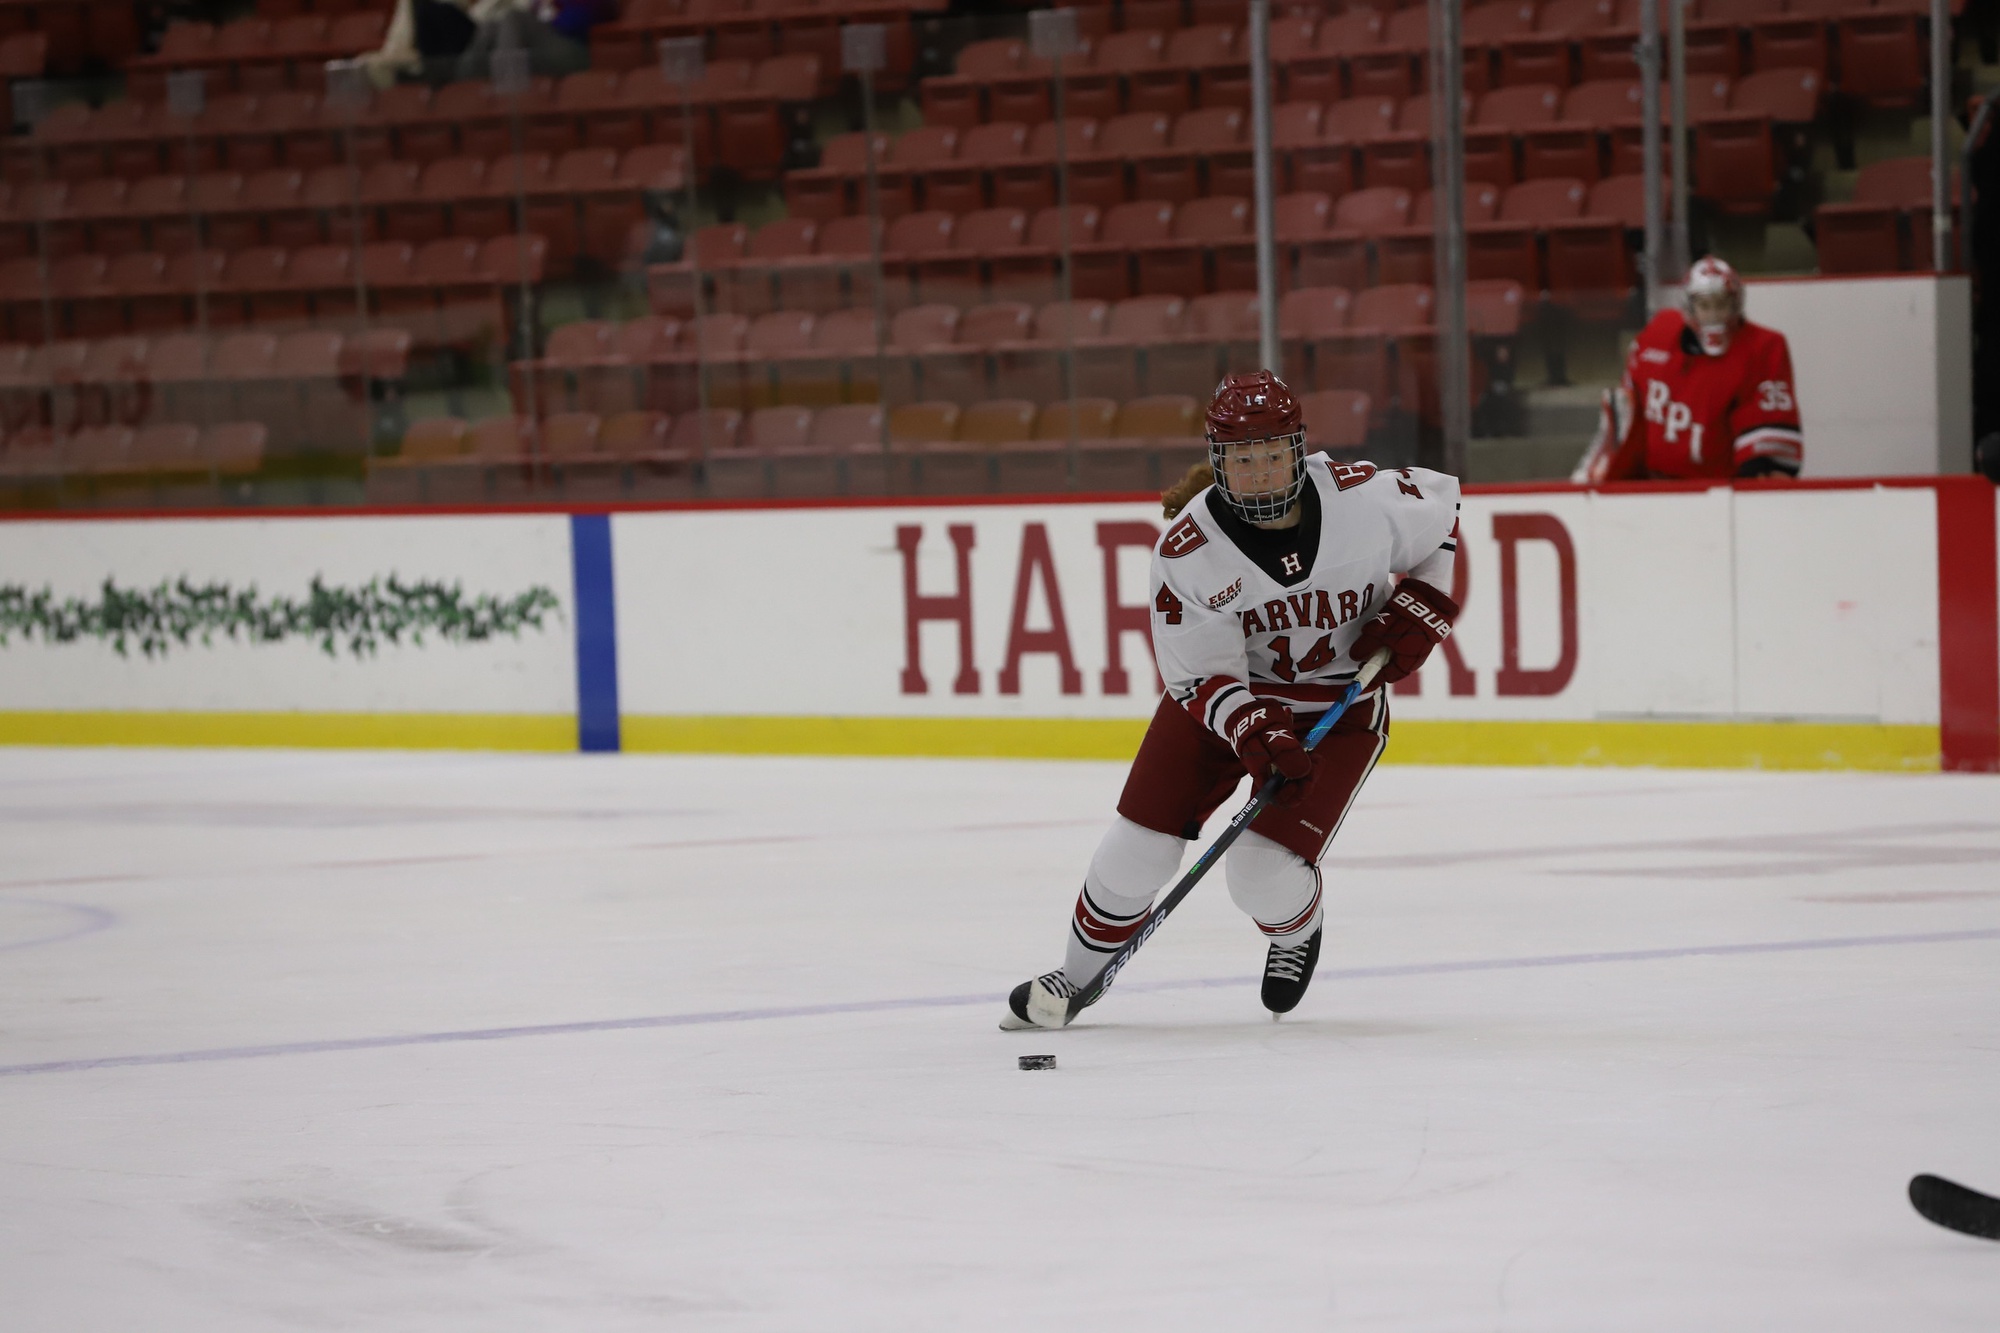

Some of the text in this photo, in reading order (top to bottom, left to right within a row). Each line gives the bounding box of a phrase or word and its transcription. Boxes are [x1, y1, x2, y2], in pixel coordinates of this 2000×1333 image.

[1245, 394, 1267, 406] 14
[1758, 380, 1793, 411] 35
[1645, 378, 1704, 463] RPI
[1334, 464, 1366, 481] H
[1167, 522, 1198, 552] H
[1281, 552, 1302, 576] H
[894, 511, 1579, 697] HARD
[1208, 577, 1242, 605] ECAC
[1236, 582, 1375, 640] ARVARD
[1267, 632, 1337, 683] 14
